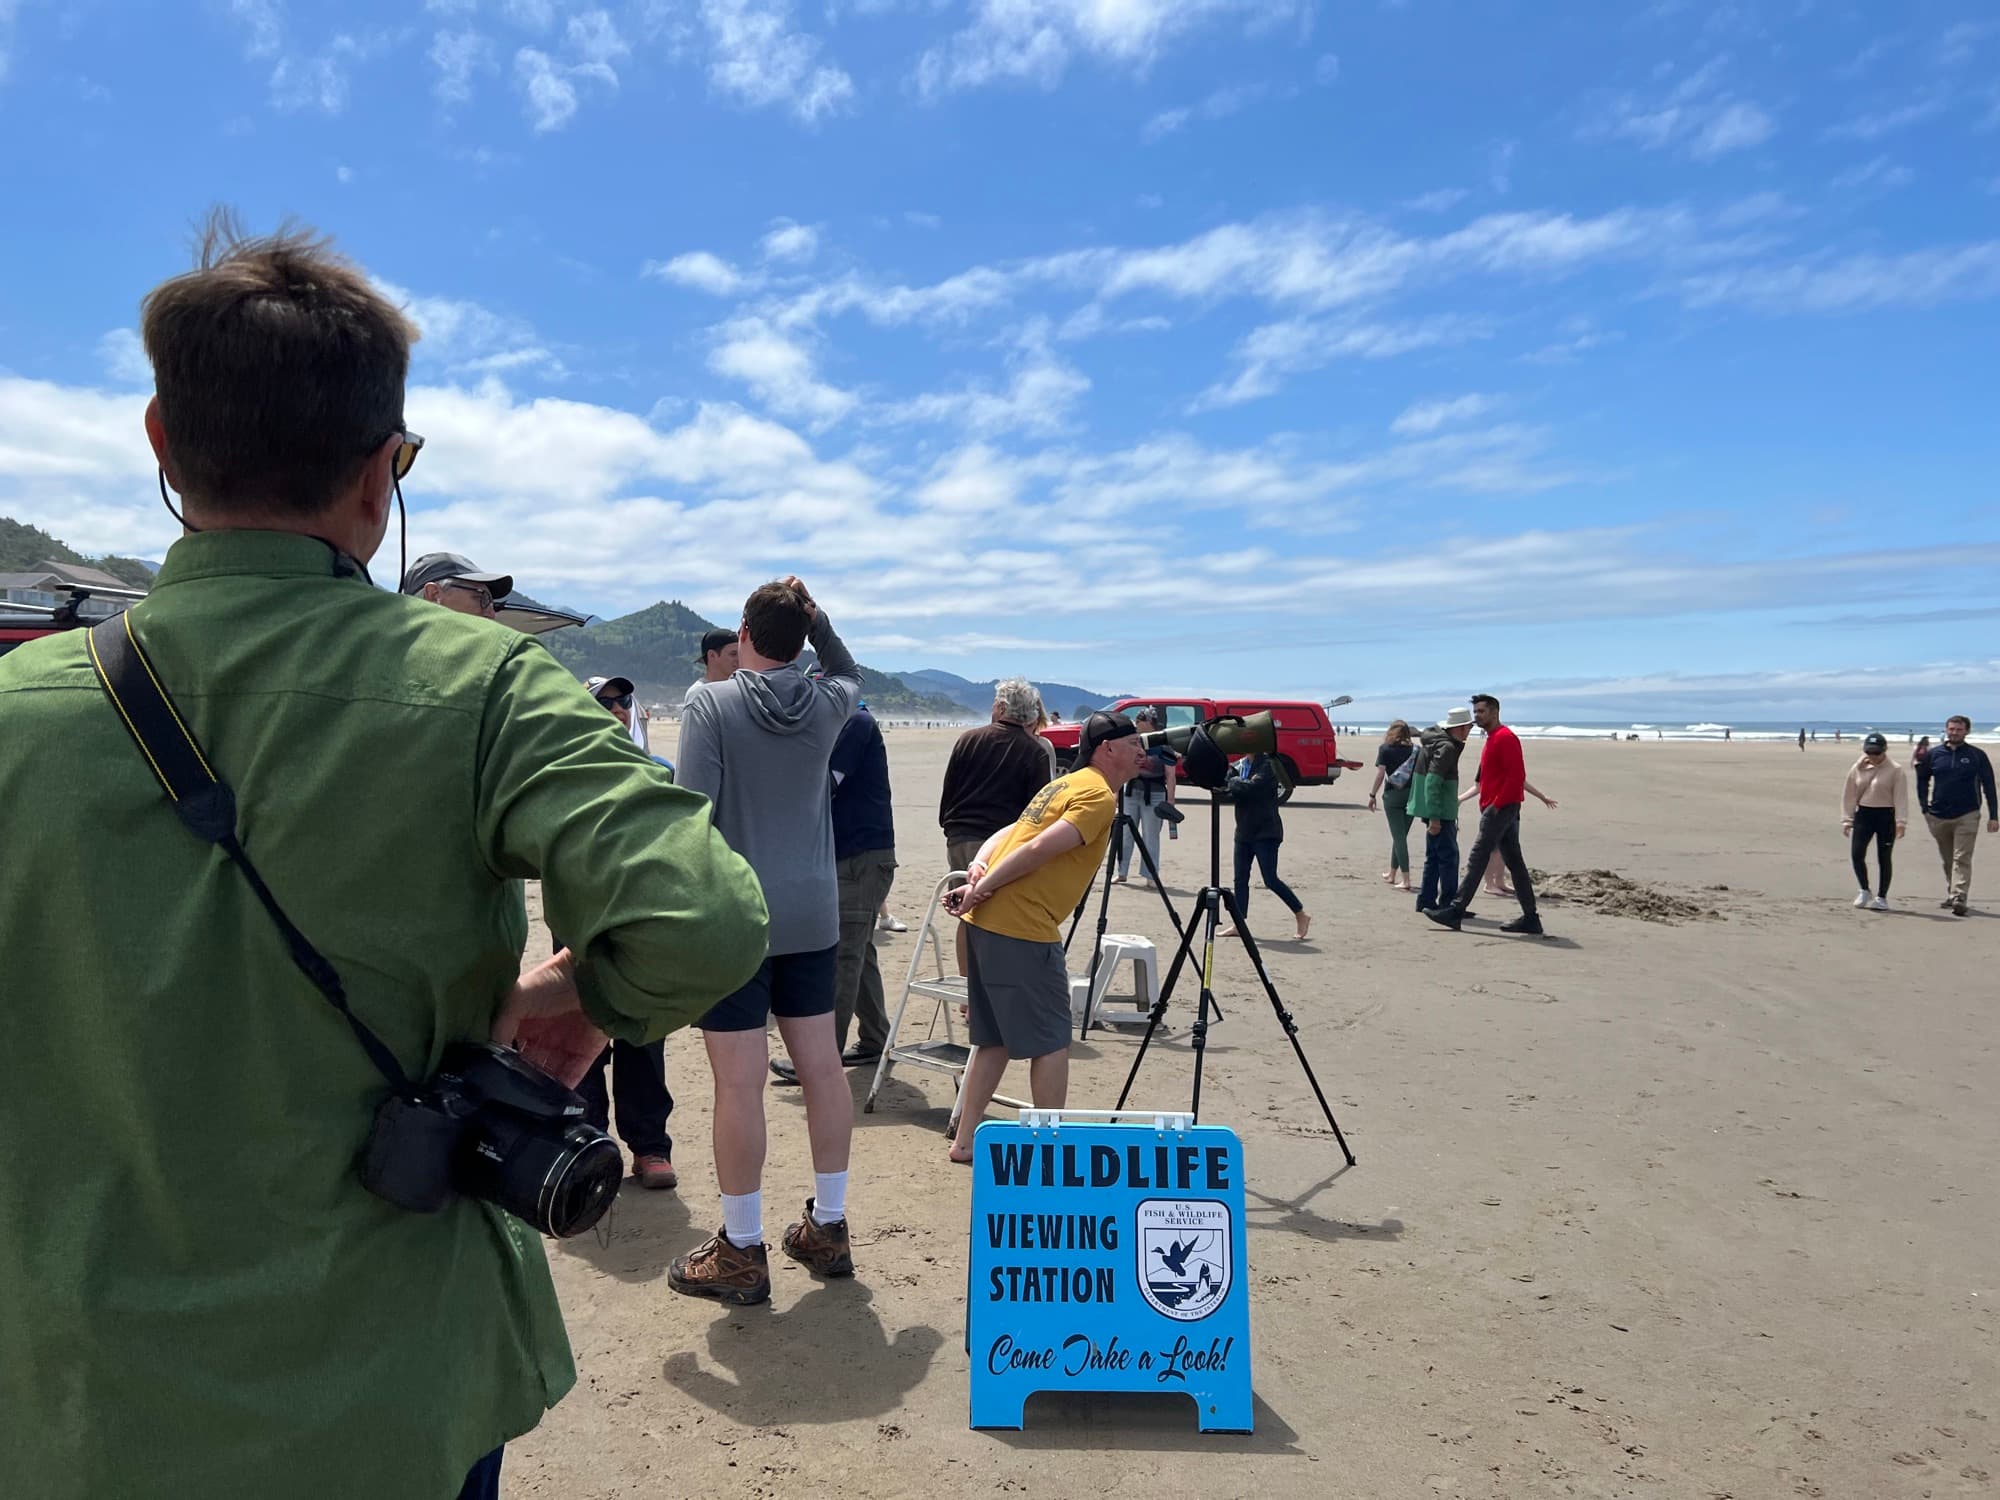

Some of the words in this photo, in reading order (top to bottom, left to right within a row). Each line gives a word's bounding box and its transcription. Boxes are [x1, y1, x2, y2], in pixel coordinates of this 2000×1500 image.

[989, 1143, 1230, 1190] WILDLIFE
[1175, 1203, 1193, 1211] U.S.
[987, 1213, 1118, 1251] VIEWING
[989, 1266, 1115, 1303] STATION
[987, 1334, 1056, 1376] Come
[1062, 1334, 1133, 1377] Take
[1137, 1355, 1156, 1371] a
[1157, 1335, 1234, 1383] Look!
